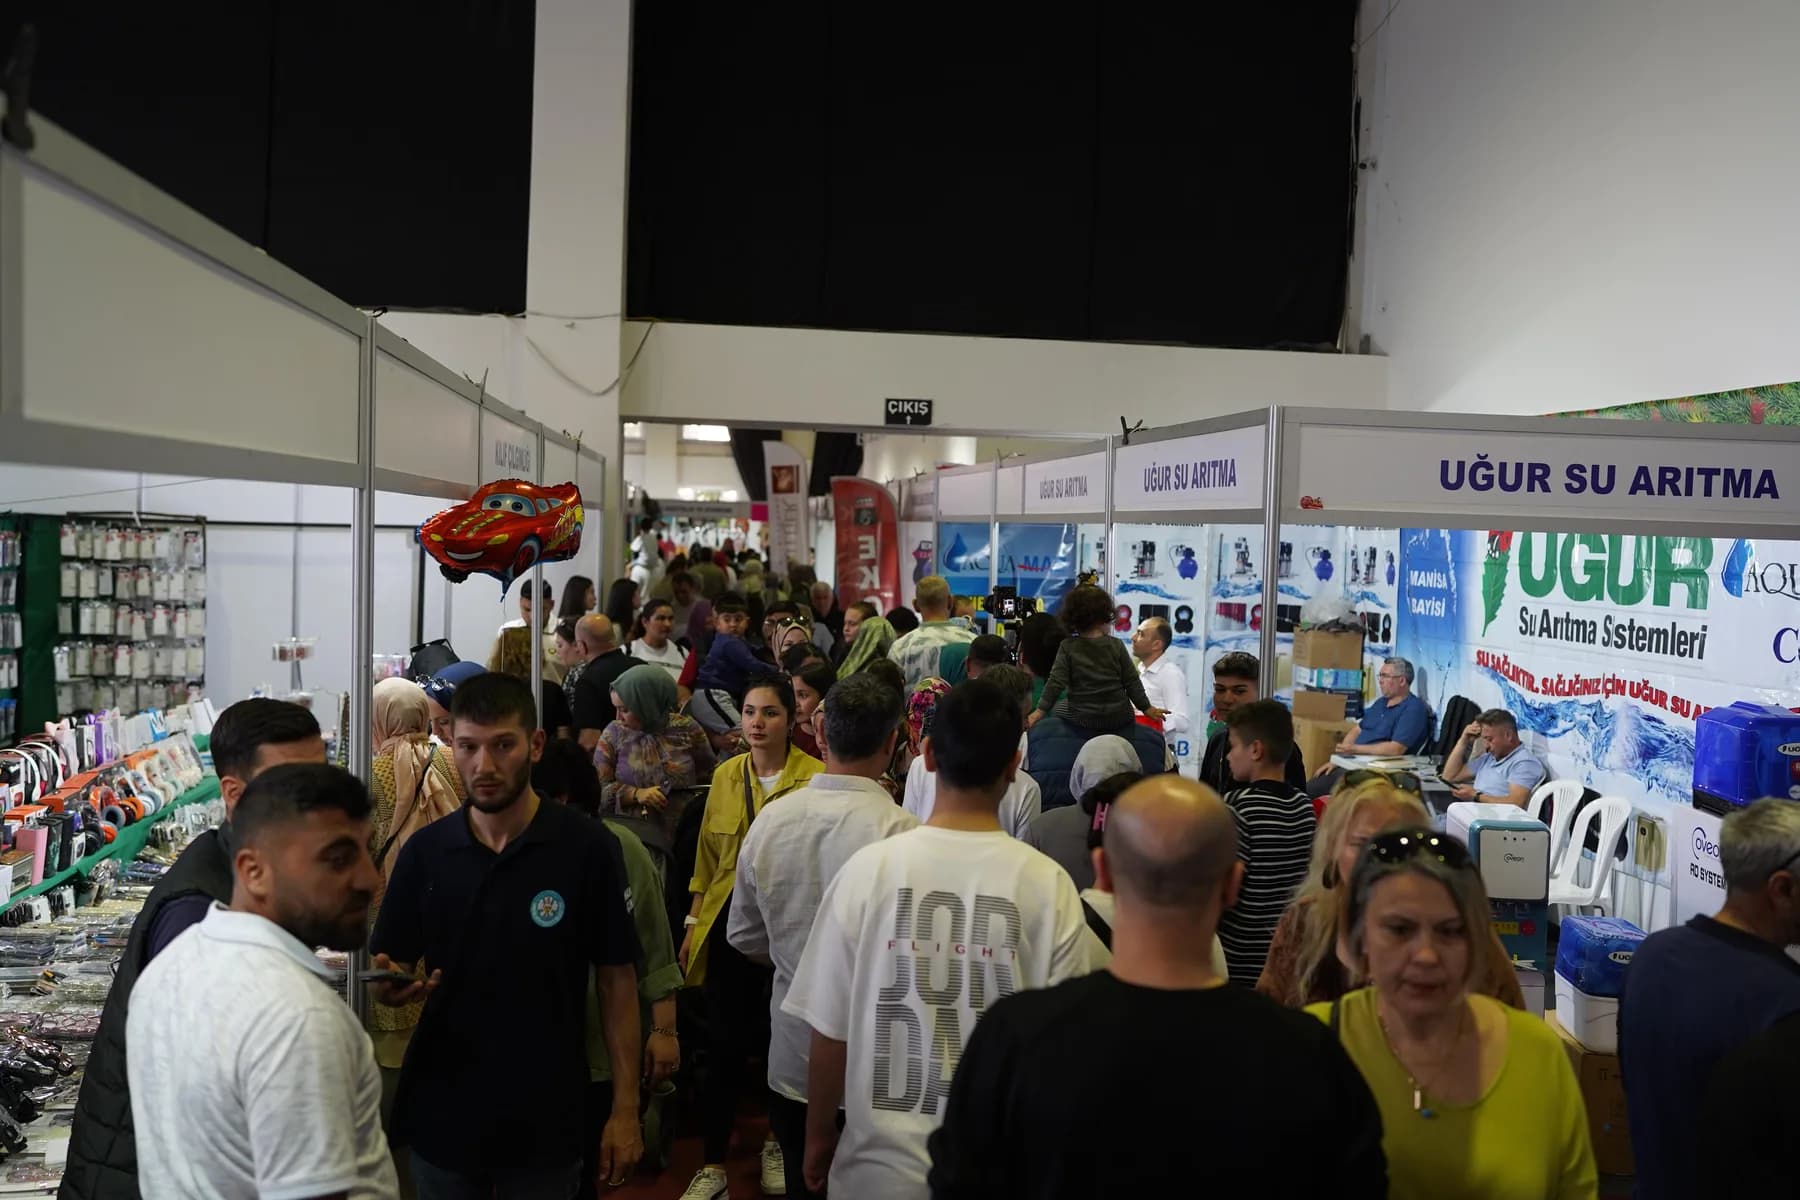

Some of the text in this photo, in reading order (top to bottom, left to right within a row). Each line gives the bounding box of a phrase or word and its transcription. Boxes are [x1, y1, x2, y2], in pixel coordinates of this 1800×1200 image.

[888, 401, 929, 415] ÇIKIŞ
[1056, 478, 1063, 499] SU
[1064, 475, 1088, 498] ARITMA
[1144, 458, 1236, 492] UĞUR SU ARITMA
[1439, 453, 1779, 499] UĞUR SU ARITMA
[1410, 569, 1447, 590] MANİSA
[1411, 596, 1446, 618] BAYİSİ
[1519, 606, 1708, 660] Su Arıtma Sistemleri
[1476, 650, 1490, 667] SU
[1541, 674, 1601, 697] SAĞLIĞINIZ
[1602, 672, 1627, 699] İÇİN
[1629, 679, 1668, 710] UĞUR
[1671, 696, 1691, 719] SU
[888, 940, 1016, 960] FLIGHT
